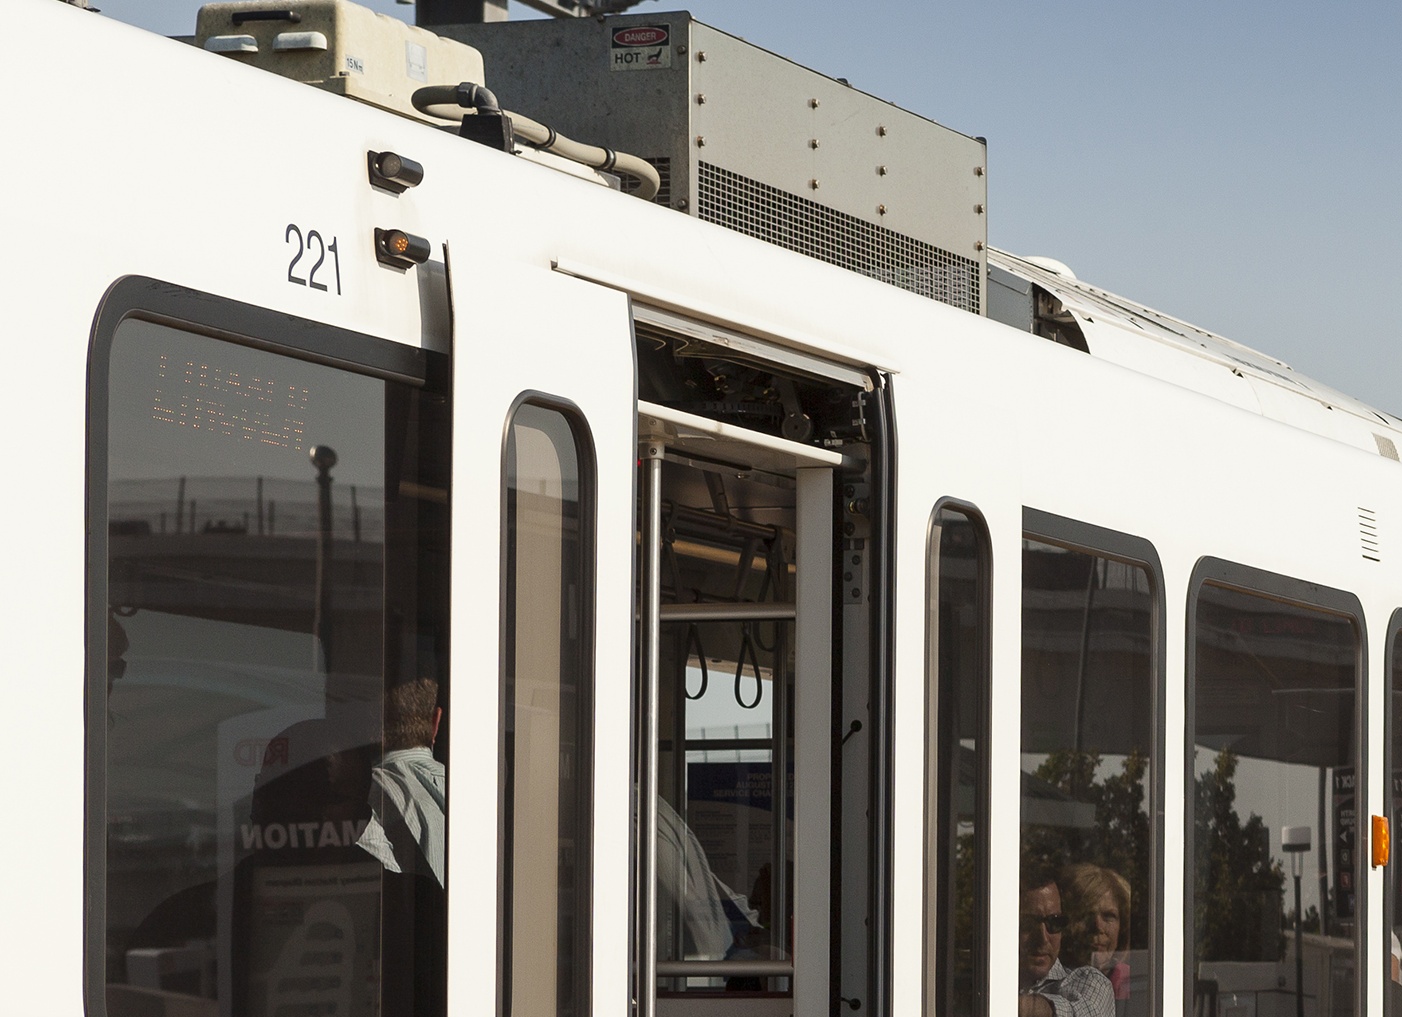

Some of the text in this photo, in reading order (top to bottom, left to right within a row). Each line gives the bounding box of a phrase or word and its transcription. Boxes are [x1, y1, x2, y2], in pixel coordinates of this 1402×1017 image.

[624, 31, 657, 42] DANGER
[614, 52, 641, 64] HOT
[285, 223, 343, 296] 221
